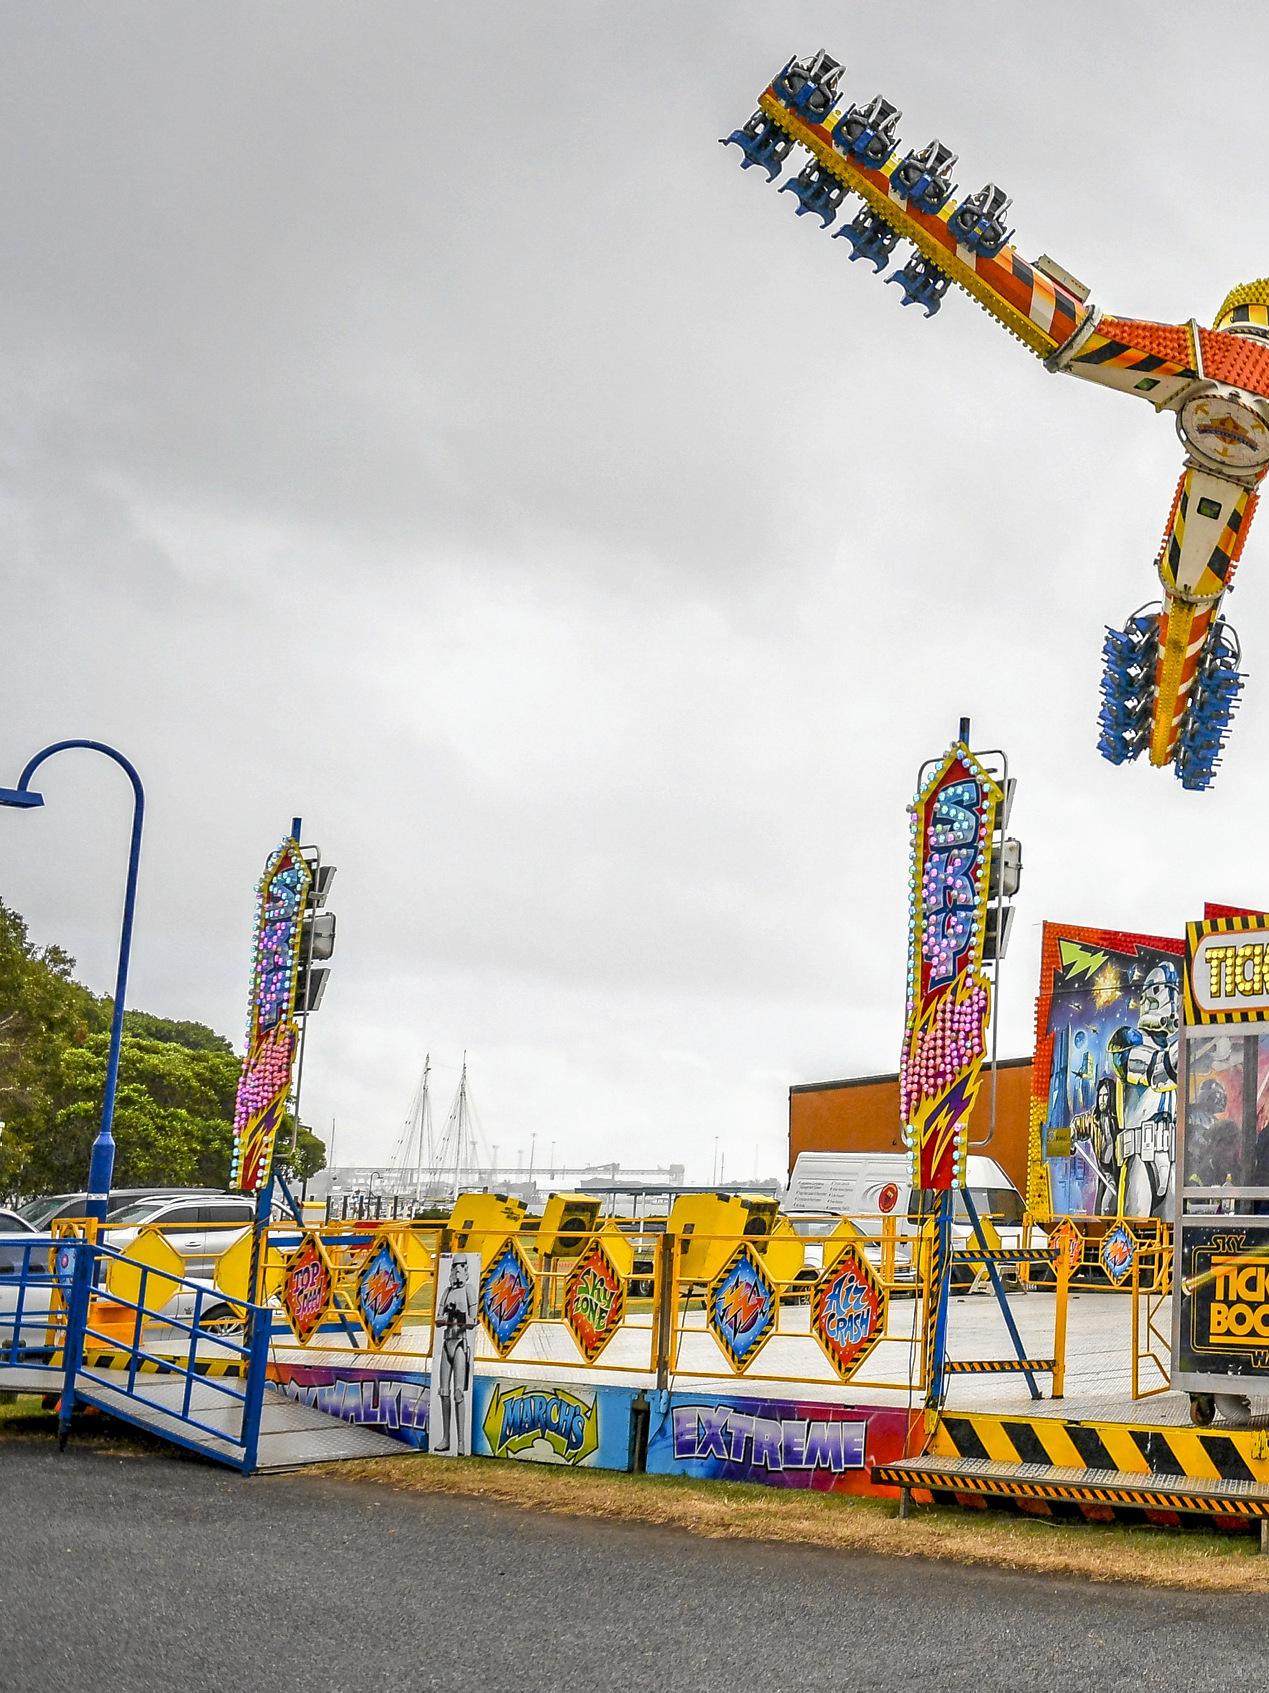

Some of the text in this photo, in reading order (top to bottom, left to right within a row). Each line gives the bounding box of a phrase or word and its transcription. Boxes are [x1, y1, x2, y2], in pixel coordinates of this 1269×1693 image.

[1212, 1235, 1246, 1252] SKY
[292, 1261, 321, 1295] TOP
[826, 1306, 871, 1347] CRASH
[672, 1404, 866, 1472] EXTREME
